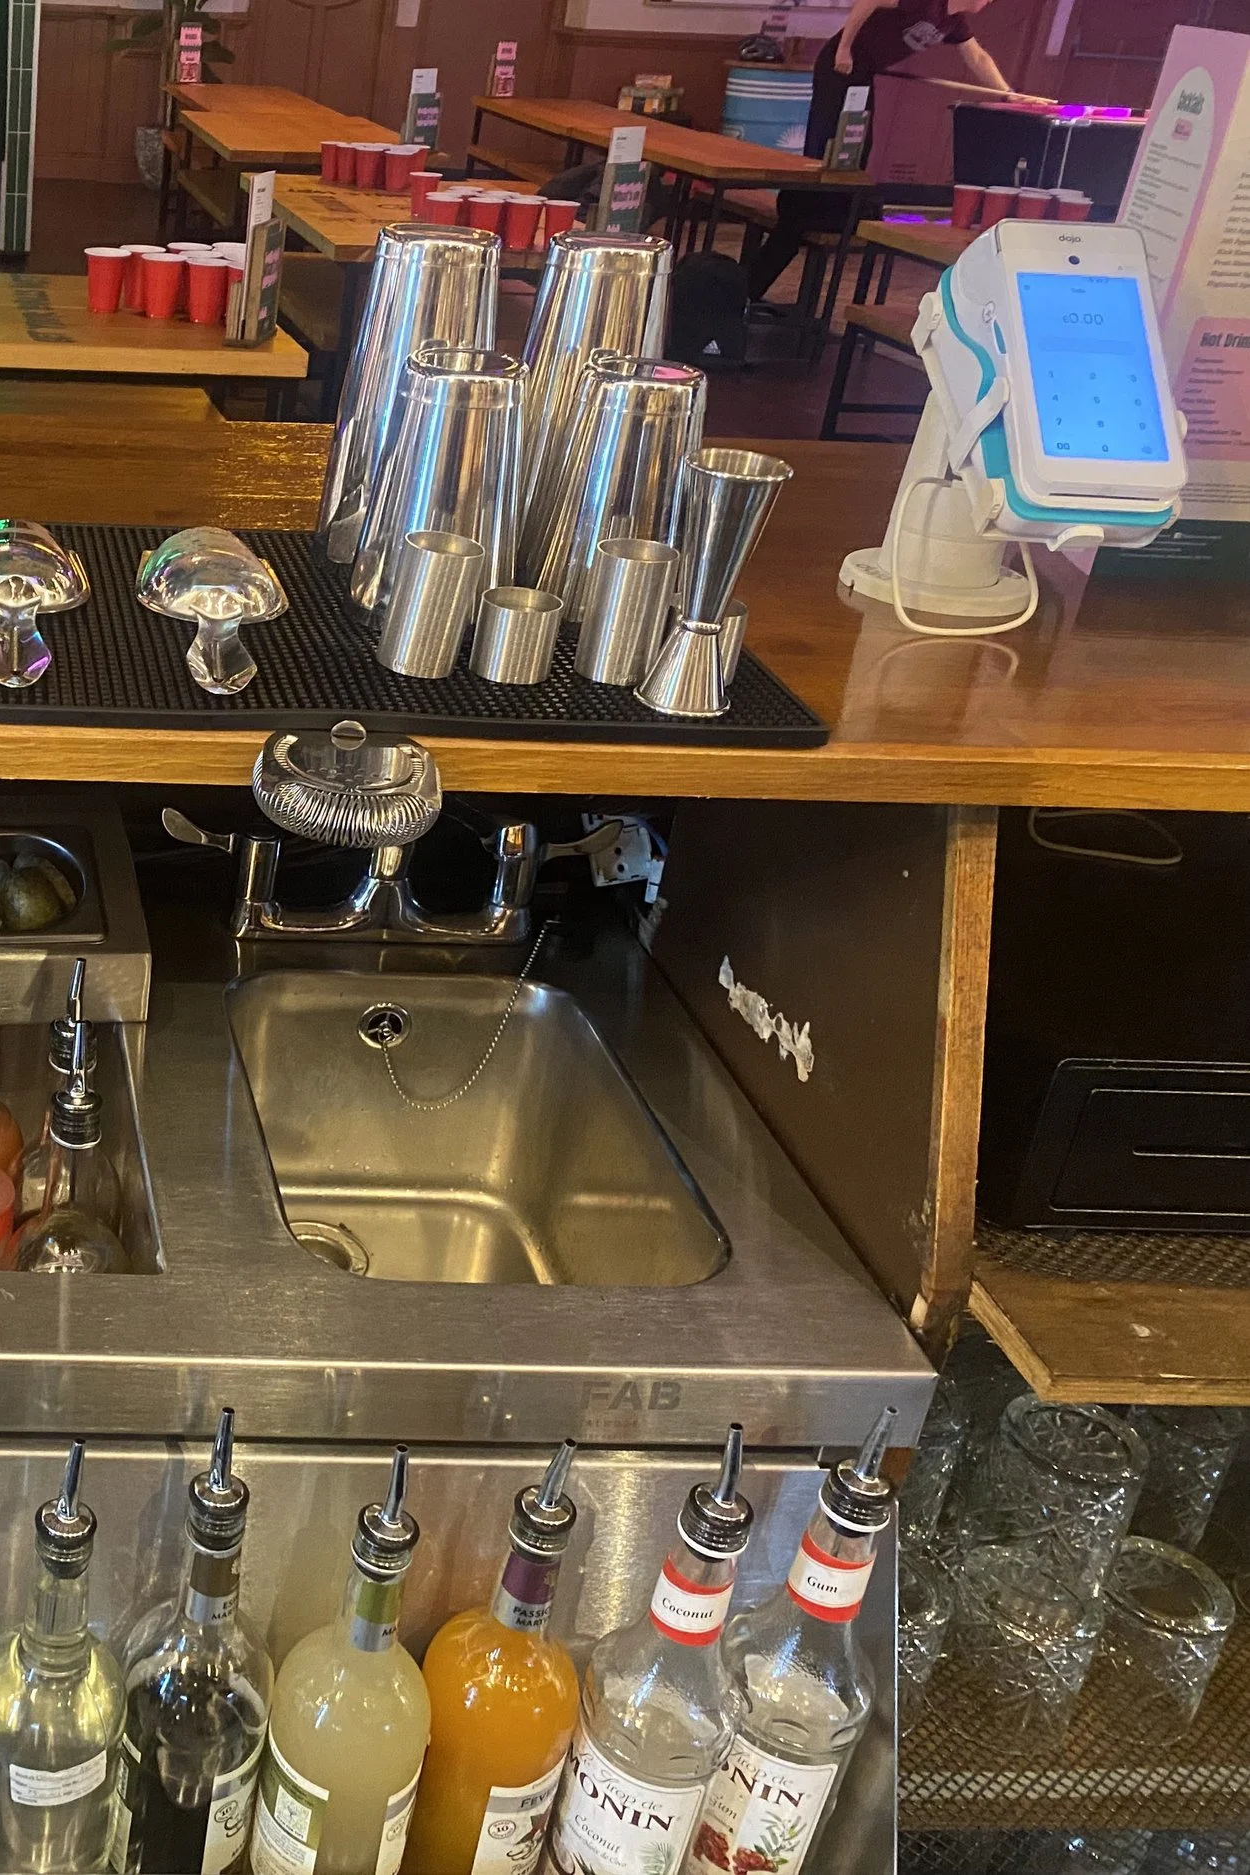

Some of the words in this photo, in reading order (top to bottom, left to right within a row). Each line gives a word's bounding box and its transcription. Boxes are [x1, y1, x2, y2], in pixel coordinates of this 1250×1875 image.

[1058, 233, 1082, 244] dojo
[1199, 332, 1223, 346] Hot
[581, 1381, 681, 1411] FAB
[806, 1575, 839, 1594] Gum
[661, 1596, 714, 1619] Coconut
[642, 1799, 663, 1812] de
[574, 1813, 621, 1854] Coconut
